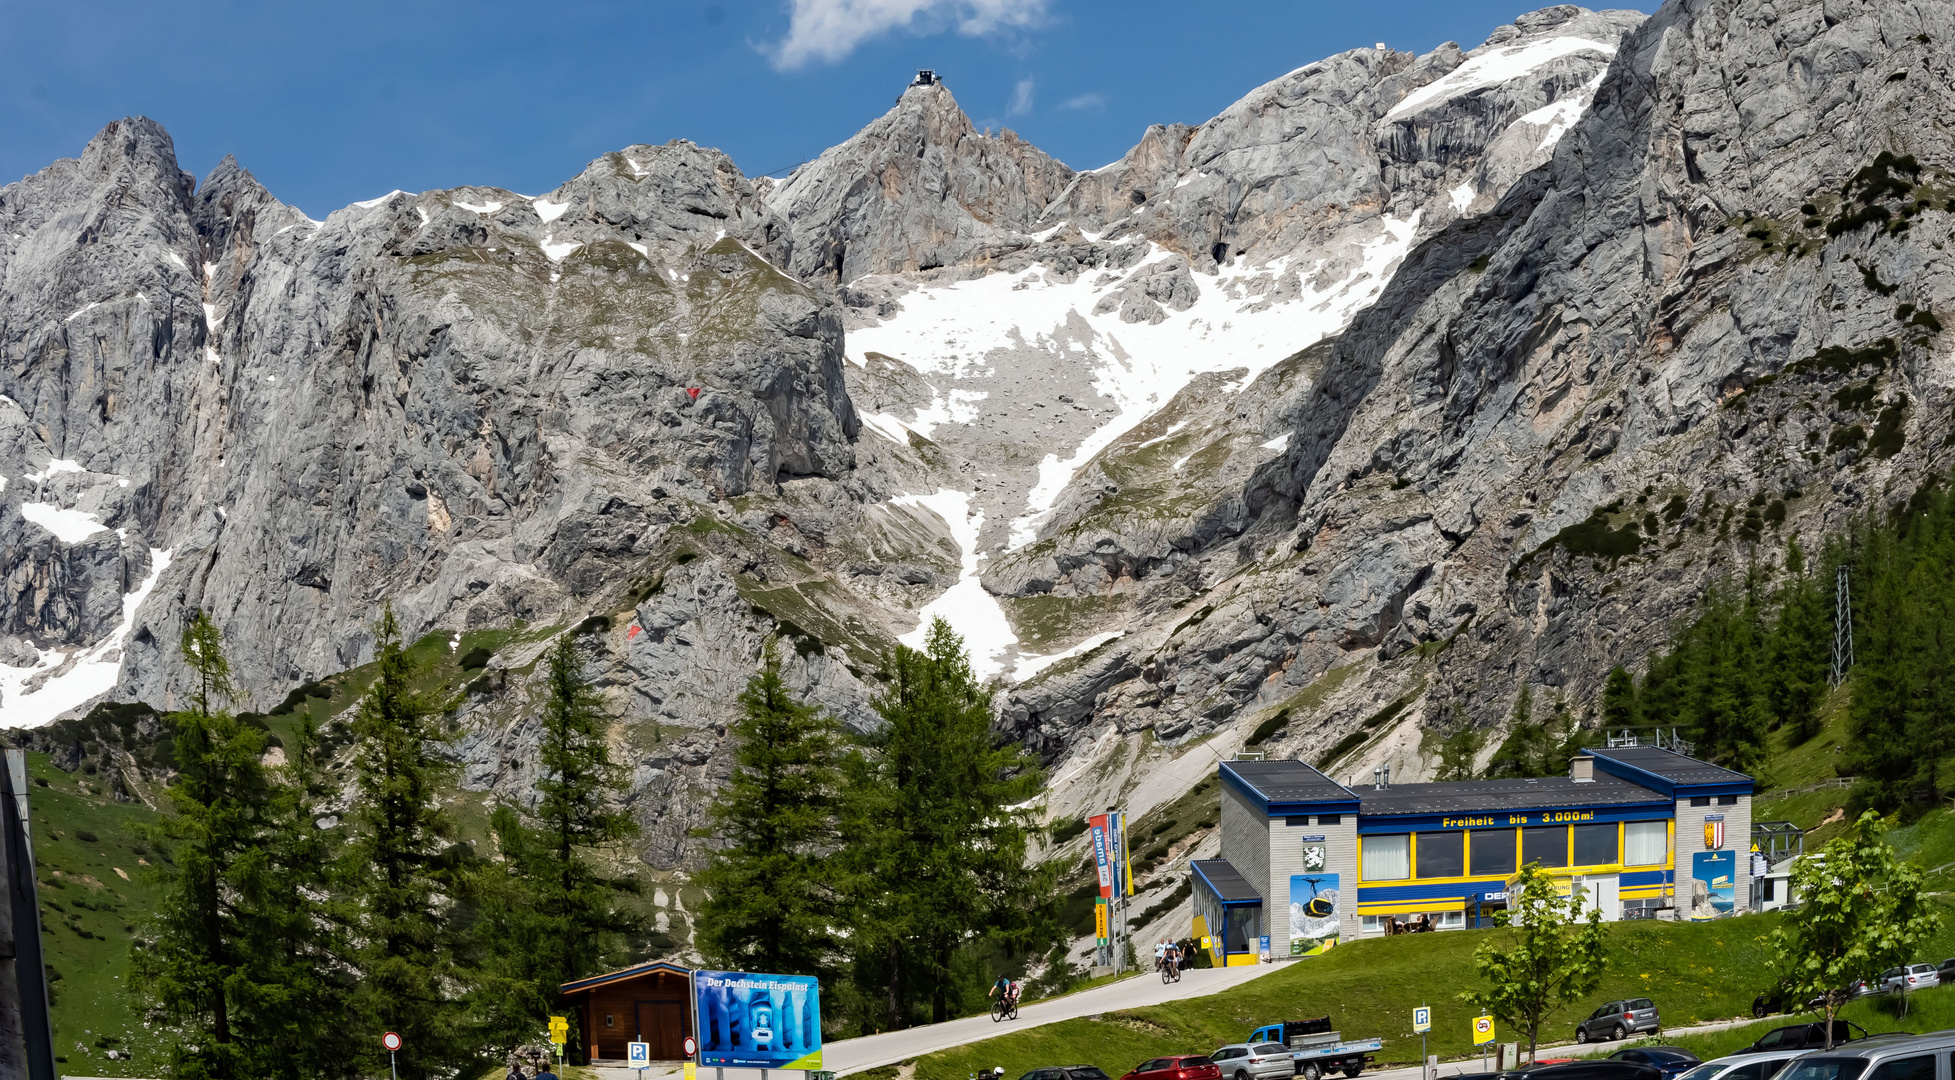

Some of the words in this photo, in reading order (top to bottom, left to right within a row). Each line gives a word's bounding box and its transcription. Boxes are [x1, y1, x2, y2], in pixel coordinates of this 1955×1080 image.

[1442, 816, 1495, 828] Freiheit
[1509, 814, 1528, 825] bis
[1542, 810, 1594, 823] 3.000m!
[707, 977, 723, 987] Der
[724, 978, 768, 990] Dachstein
[768, 980, 809, 992] Eispalast
[1417, 1010, 1427, 1024] P
[632, 1045, 644, 1057] P
